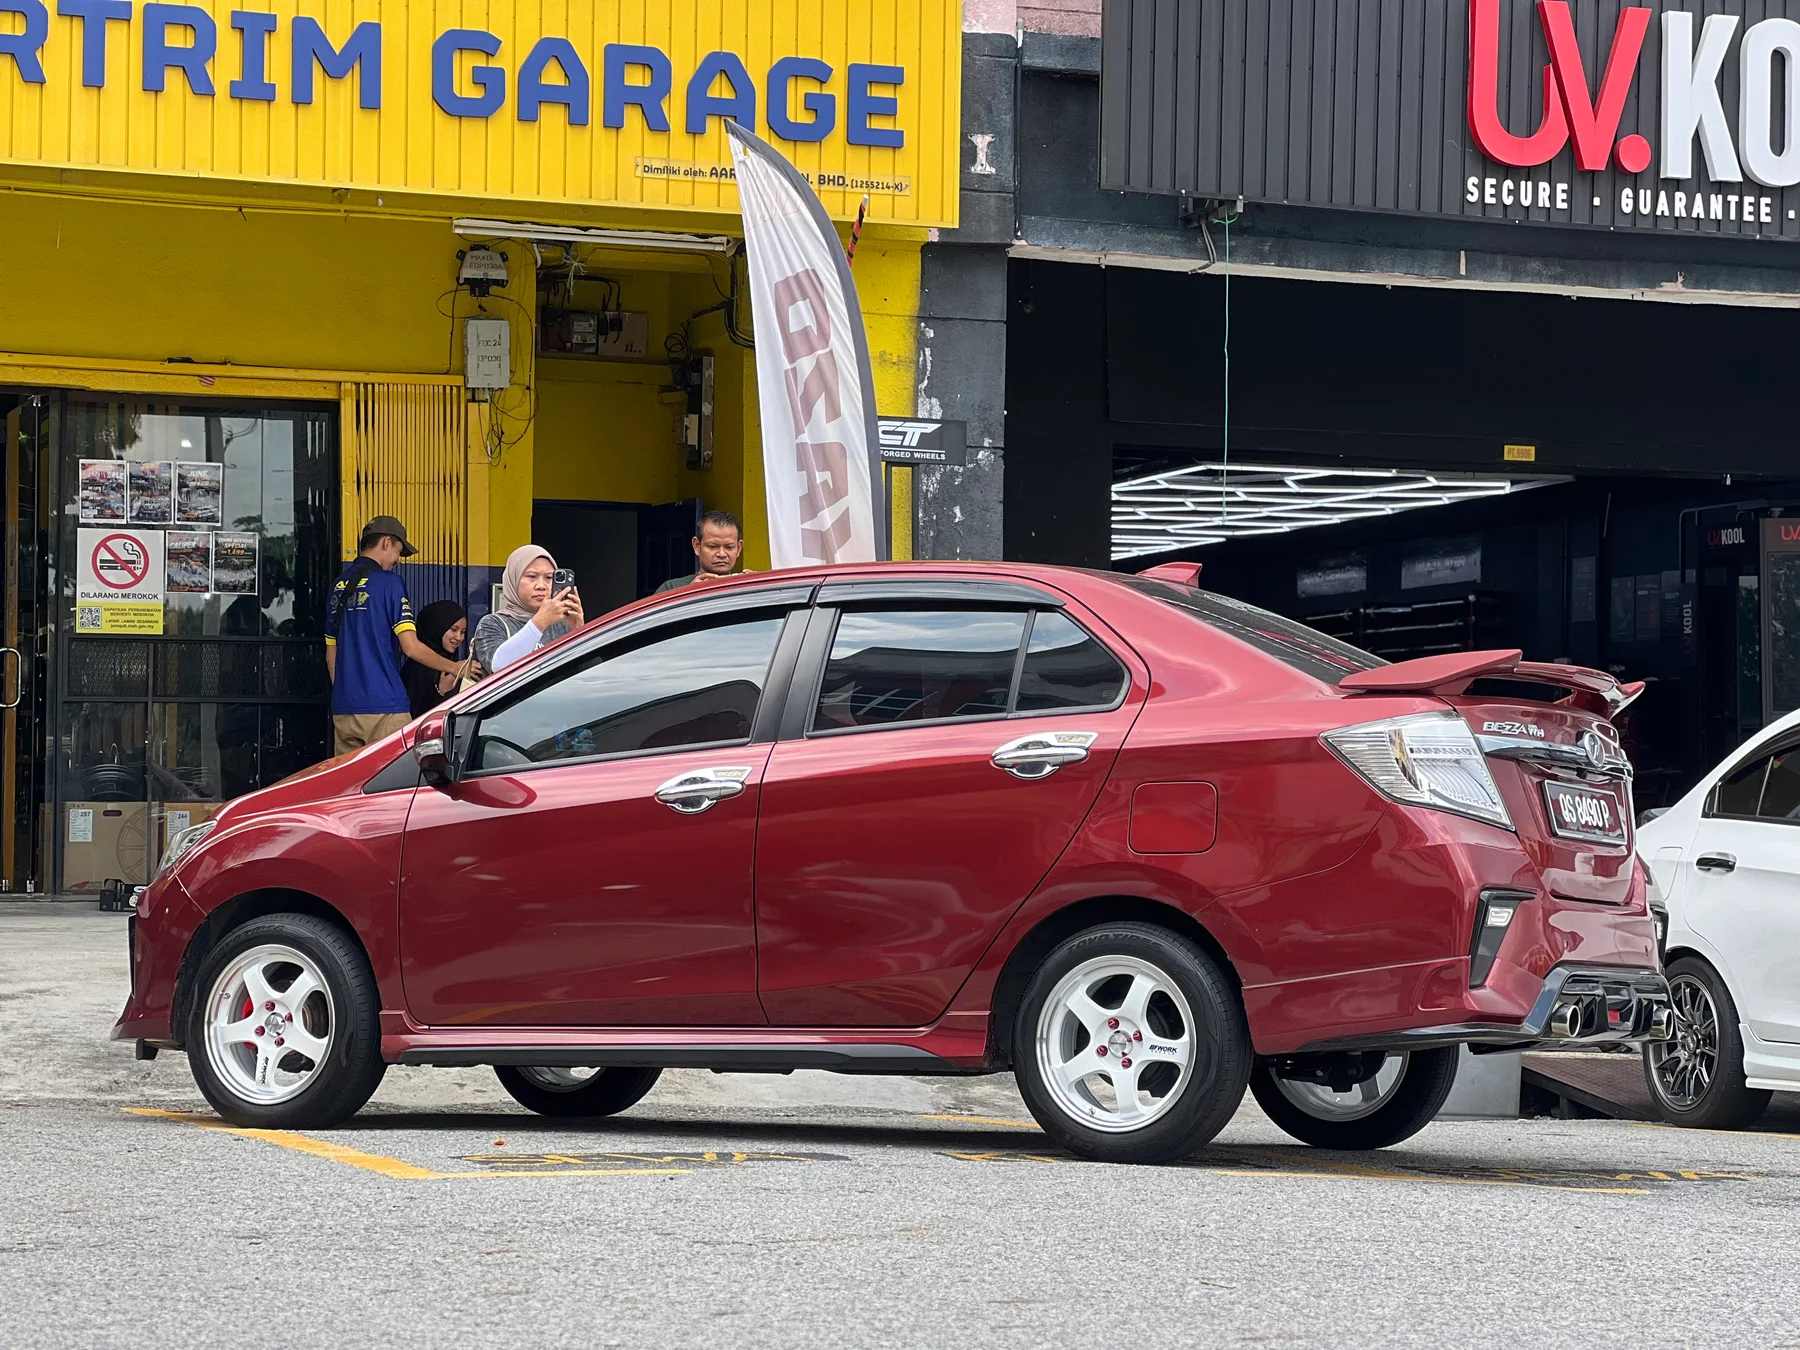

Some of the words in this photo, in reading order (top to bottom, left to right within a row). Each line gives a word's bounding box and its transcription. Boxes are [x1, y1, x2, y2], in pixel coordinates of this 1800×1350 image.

[433, 28, 905, 149] GARAGE
[643, 164, 680, 176] Dimiliki
[684, 168, 708, 177] oleh:
[818, 174, 849, 188] BHD.
[850, 178, 902, 192] (1255214-X)
[1466, 176, 1568, 210] SECURE
[1620, 188, 1772, 223] GUARANTEE
[914, 452, 946, 460] WHEELS
[1482, 721, 1527, 734] BEZZA
[1559, 793, 1576, 823] QS
[1575, 796, 1603, 827] 8490
[1600, 800, 1609, 828] P
